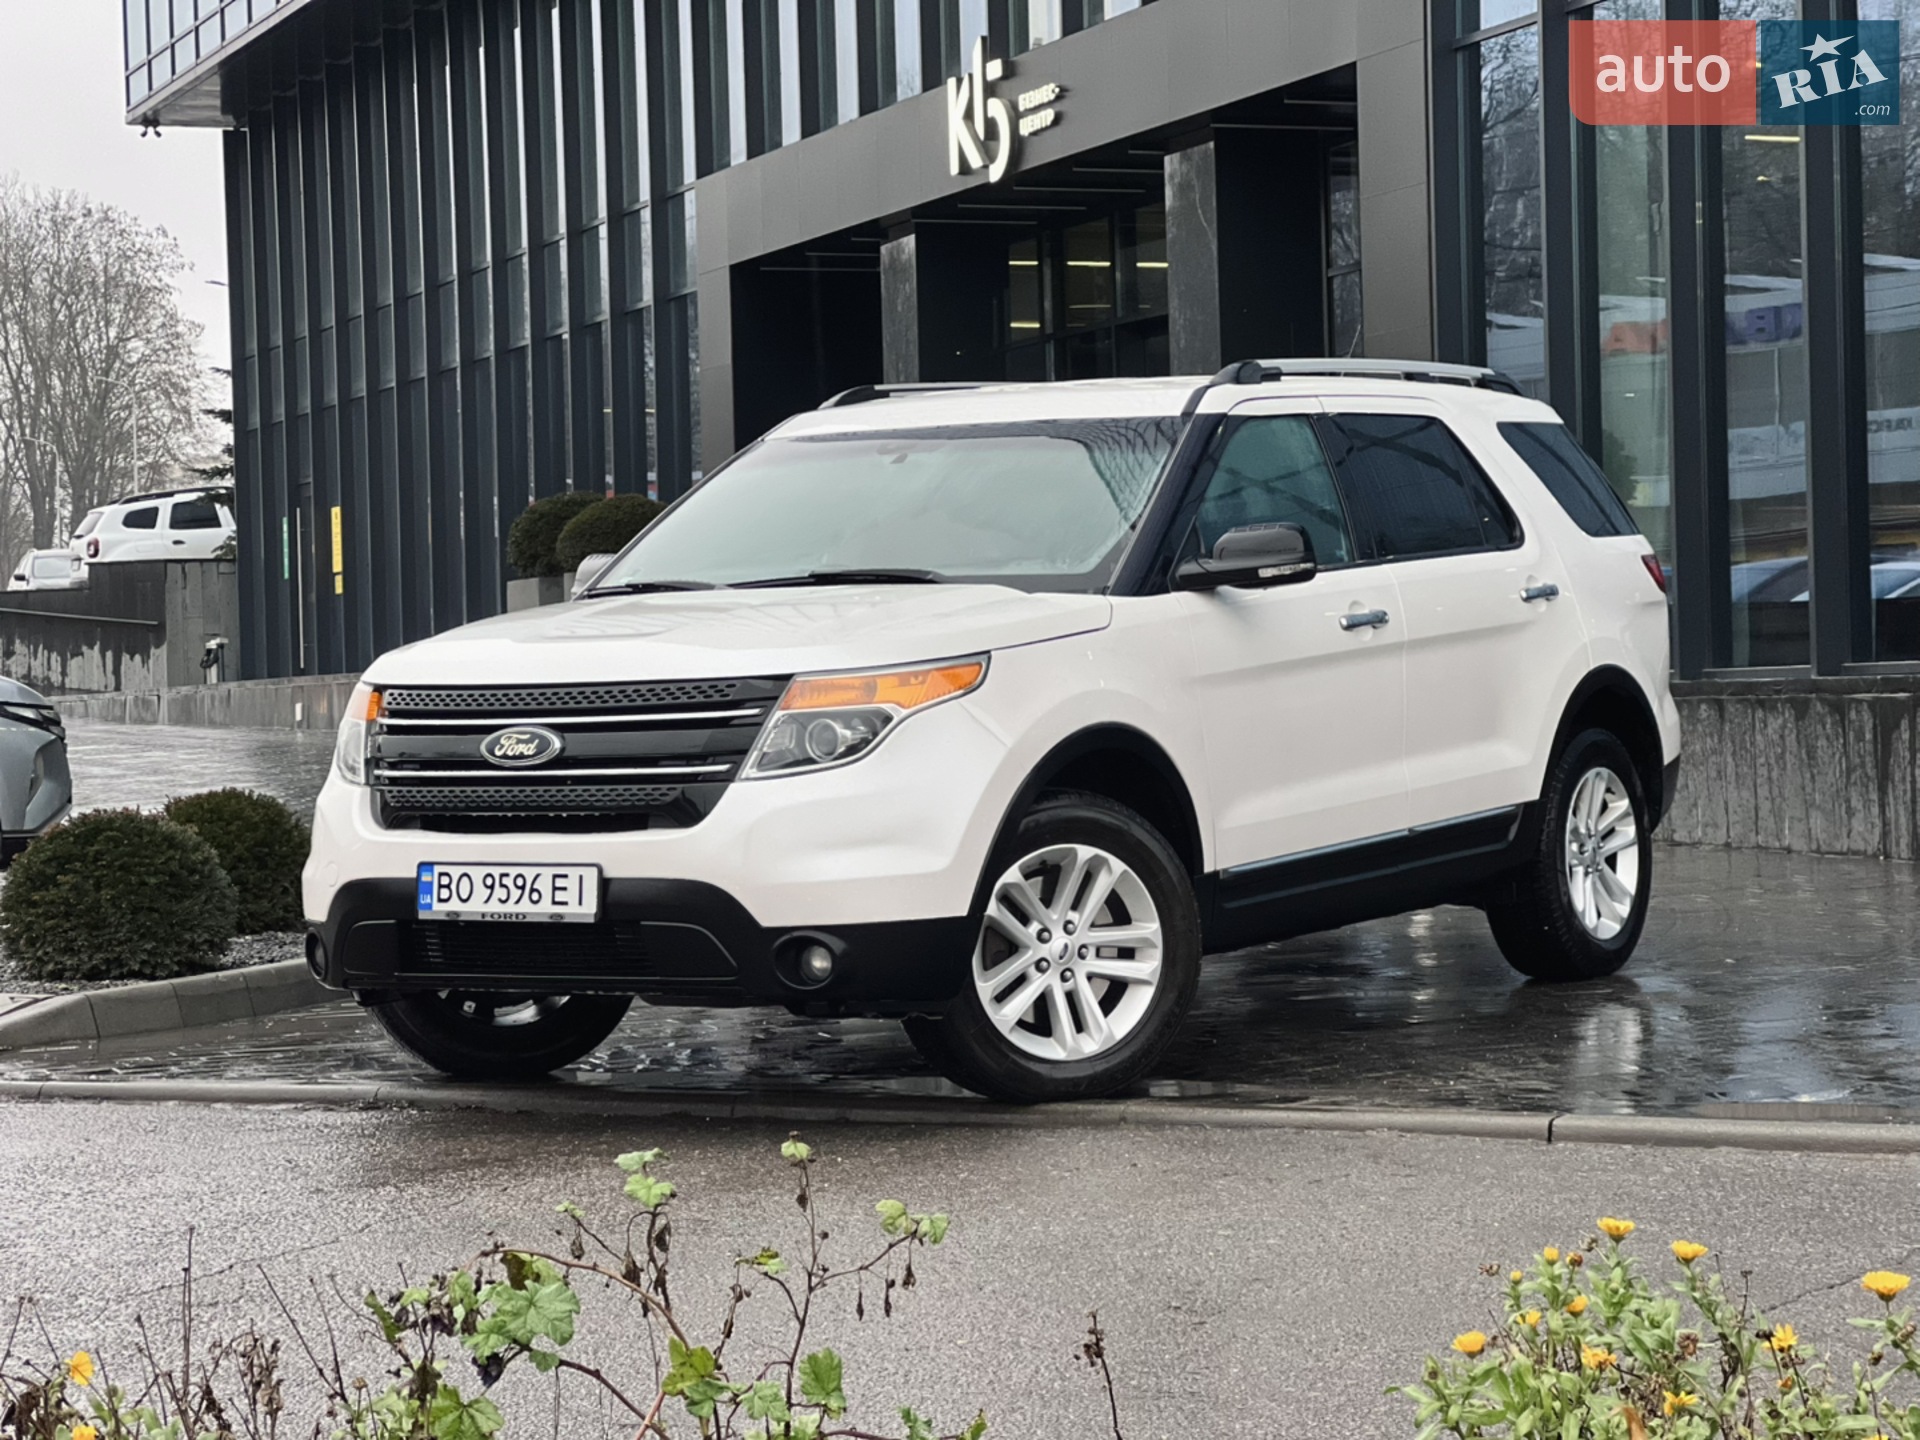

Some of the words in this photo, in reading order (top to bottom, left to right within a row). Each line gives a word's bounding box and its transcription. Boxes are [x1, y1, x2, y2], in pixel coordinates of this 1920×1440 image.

[494, 733, 540, 757] Ford
[437, 871, 475, 904] BO
[482, 872, 543, 905] 9596
[551, 873, 584, 906] EI
[420, 894, 432, 904] UA
[481, 912, 527, 921] FORD
